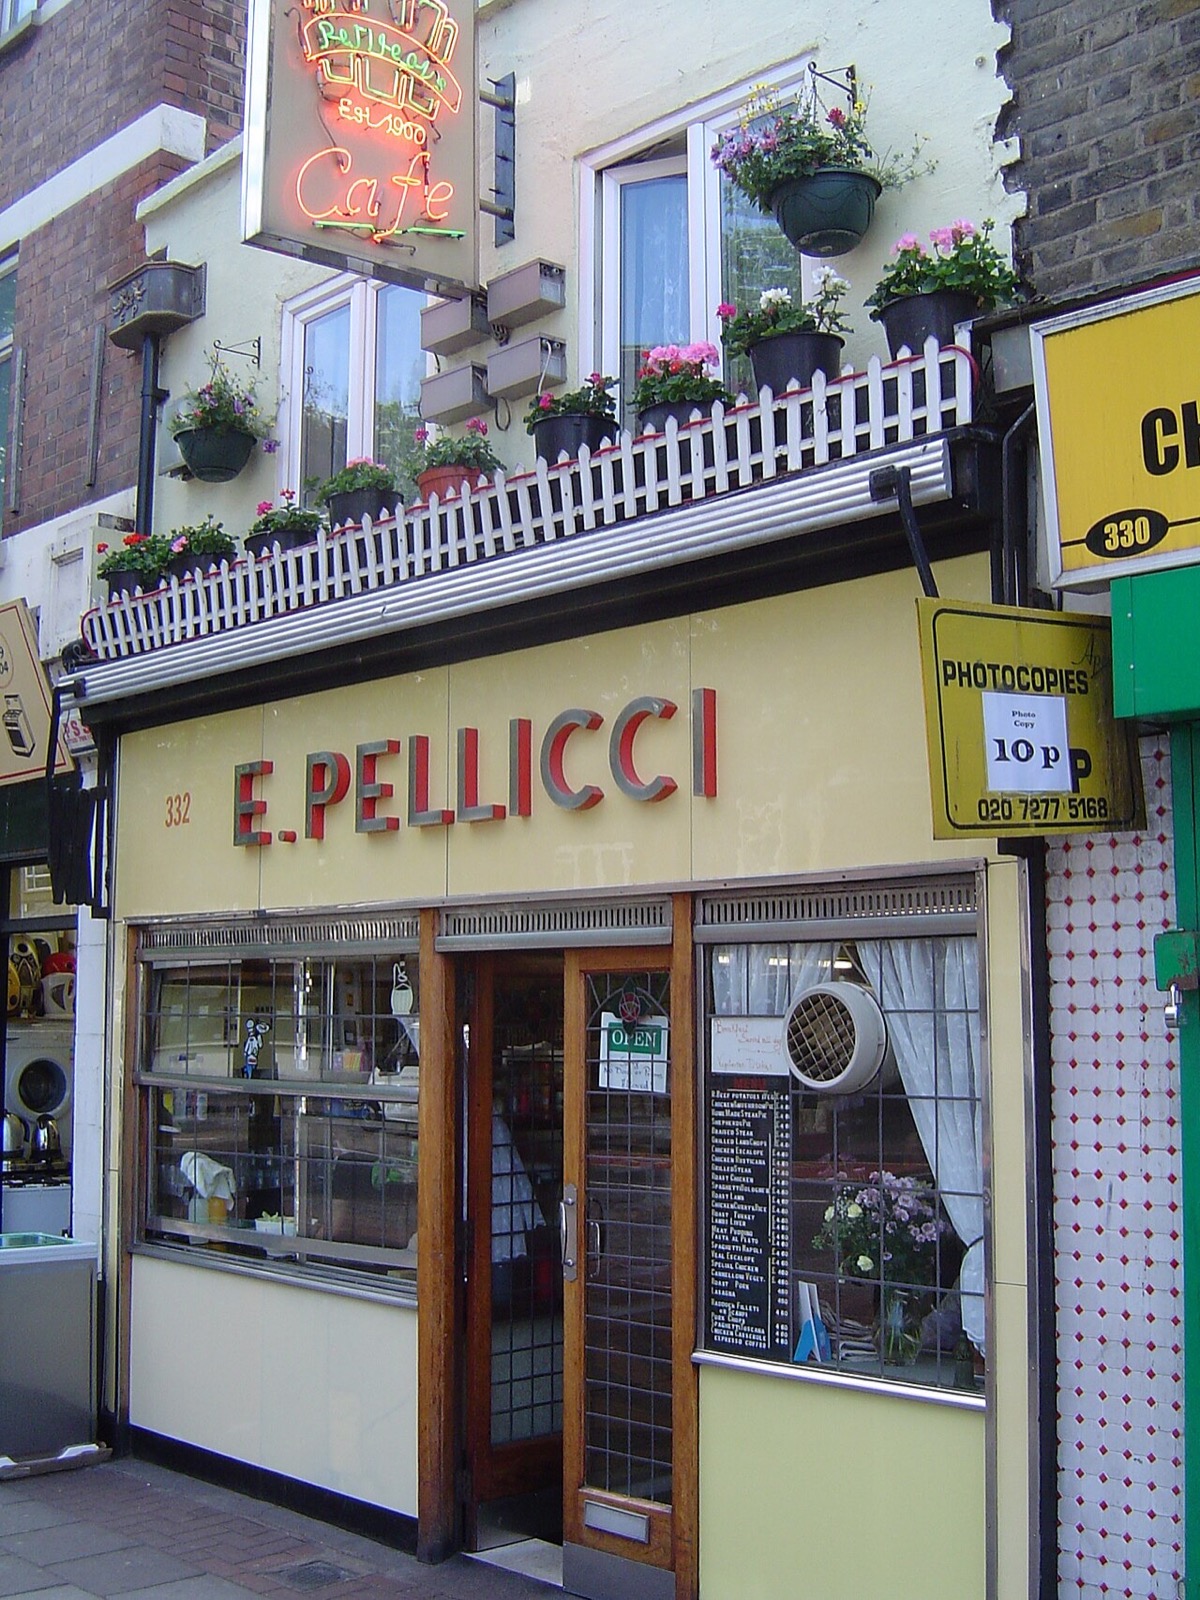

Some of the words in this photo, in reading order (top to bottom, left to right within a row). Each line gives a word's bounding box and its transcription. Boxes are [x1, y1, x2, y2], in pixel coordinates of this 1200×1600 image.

[386, 113, 426, 145] 1900
[296, 147, 454, 243] Cafe
[1103, 516, 1150, 551] 330
[942, 659, 1089, 695] PHOTOCOPIES
[1011, 710, 1036, 719] Photo
[1014, 719, 1035, 729] Copy
[164, 792, 191, 828] 332
[978, 798, 1012, 821] 020
[1020, 798, 1061, 820] 7277
[1069, 797, 1108, 819] 5168
